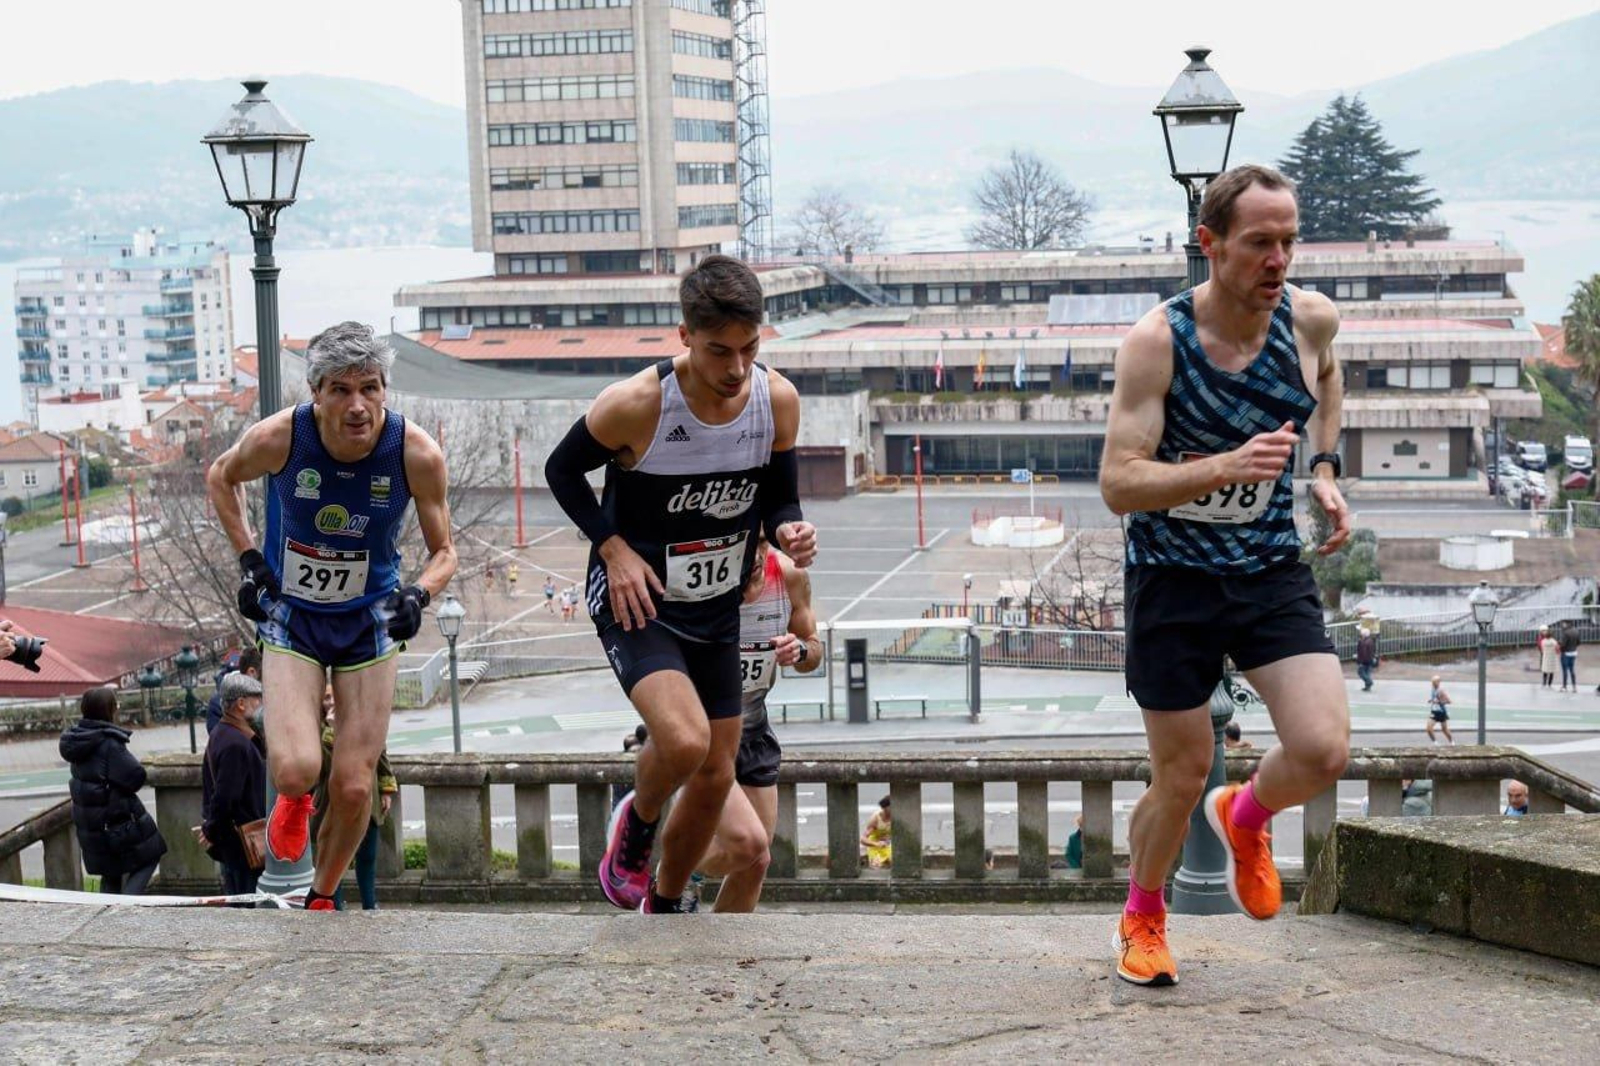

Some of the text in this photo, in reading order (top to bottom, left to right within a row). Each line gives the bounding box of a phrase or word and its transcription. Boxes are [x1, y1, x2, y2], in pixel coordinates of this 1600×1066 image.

[667, 478, 758, 513] delikia
[719, 502, 740, 514] fresh
[319, 511, 370, 532] Ulla Oil
[298, 563, 350, 591] 297
[686, 556, 729, 589] 316
